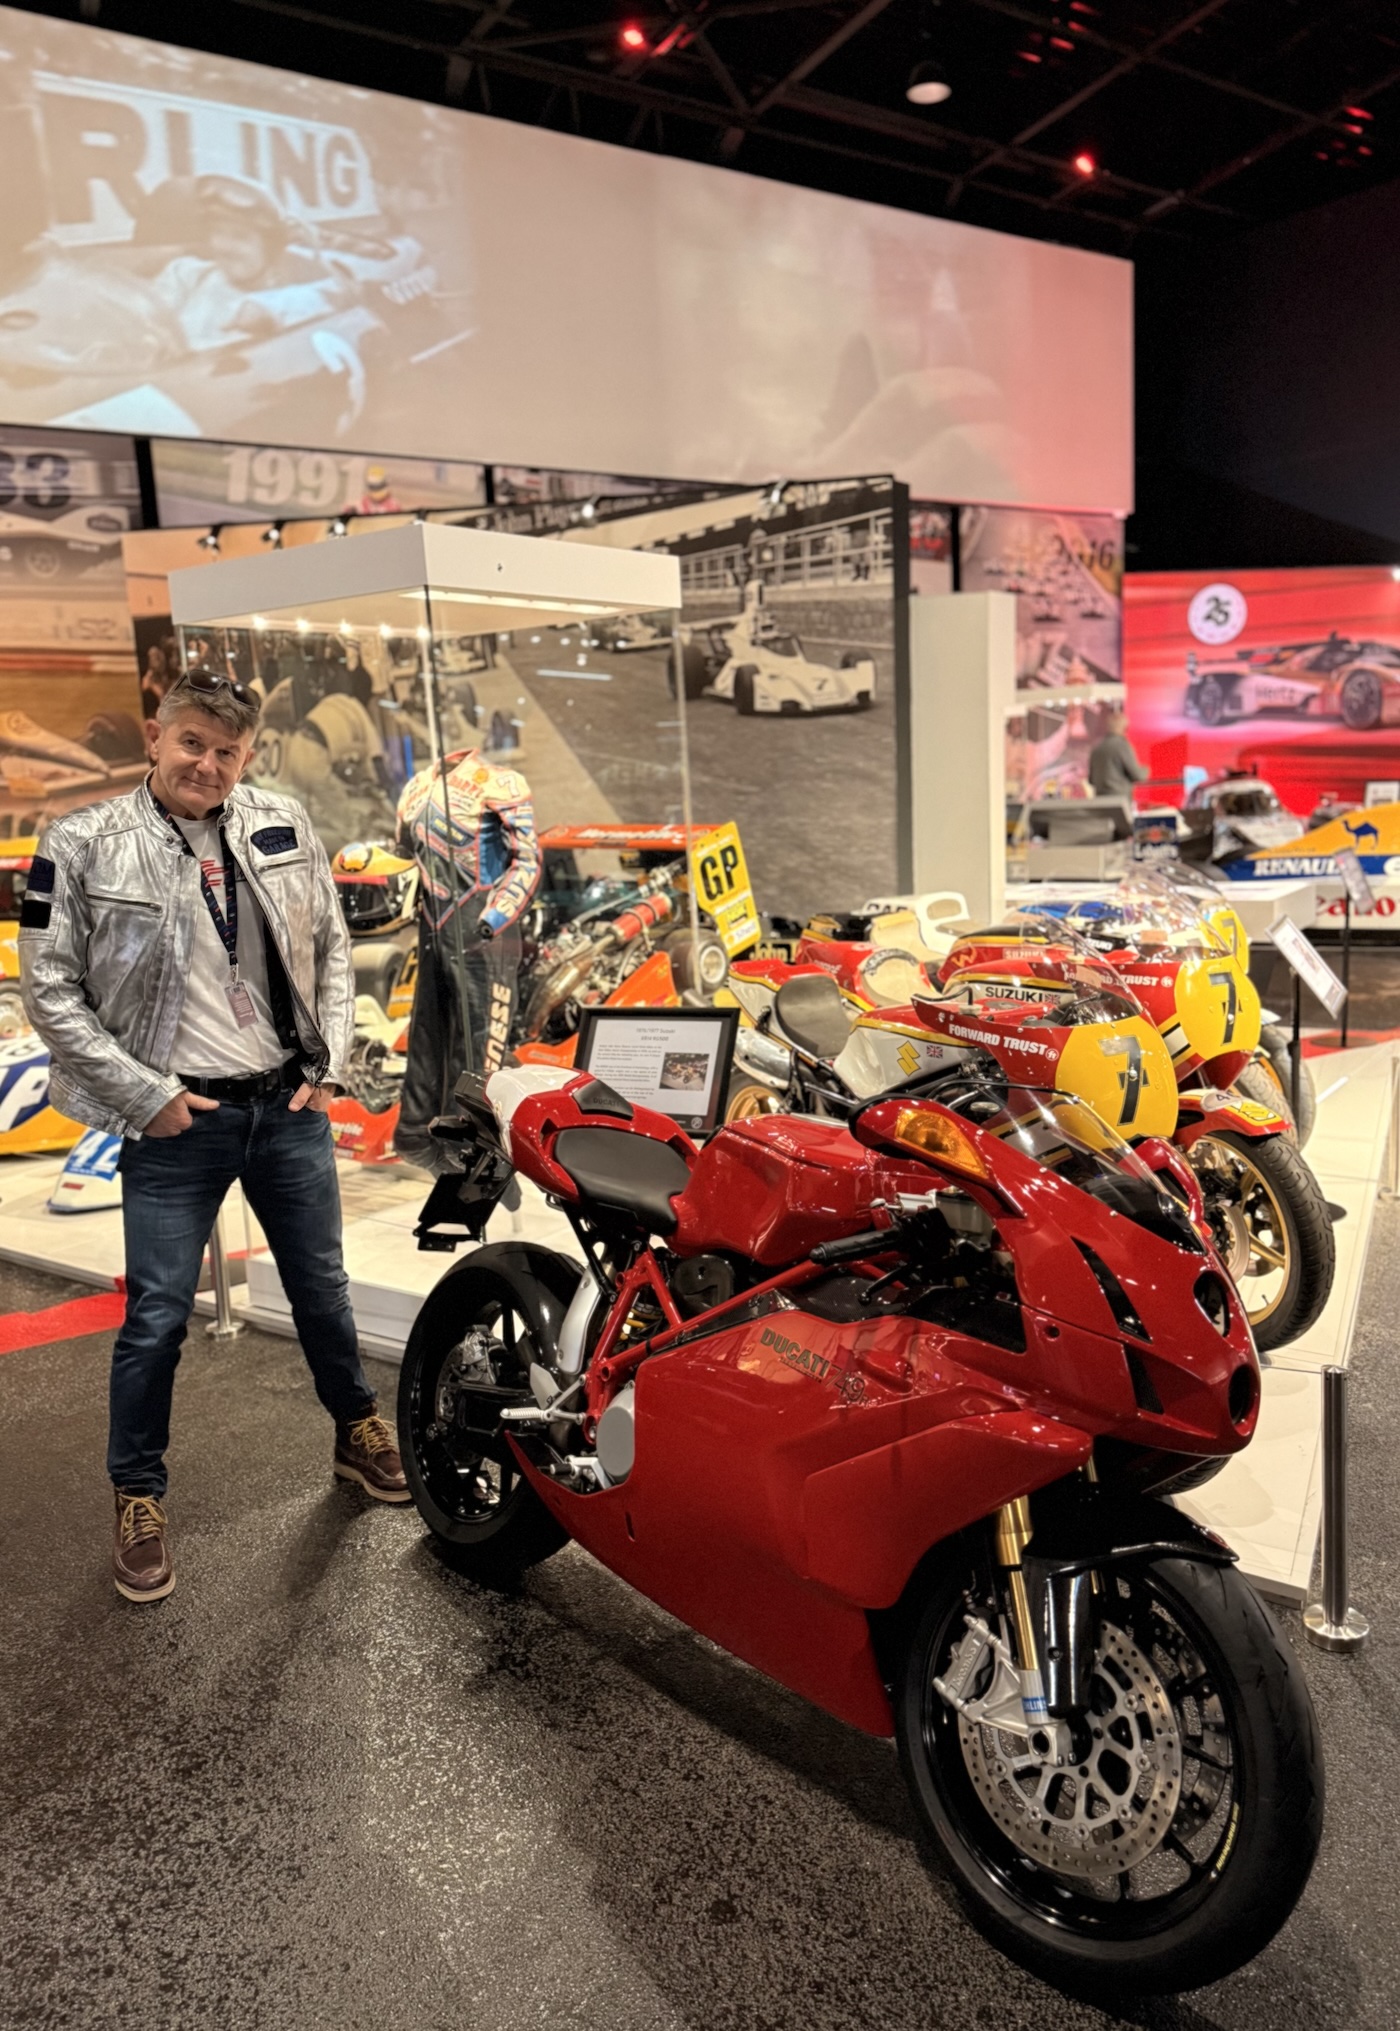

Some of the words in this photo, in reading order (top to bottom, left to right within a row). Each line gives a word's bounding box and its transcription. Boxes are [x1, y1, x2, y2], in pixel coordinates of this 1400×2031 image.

[222, 447, 367, 508] 1991
[496, 774, 520, 799] 7
[262, 839, 296, 854] GARAGE
[496, 816, 537, 917] SUZUKI
[700, 845, 739, 901] GP
[1252, 857, 1342, 877] RENAUL
[985, 986, 1043, 1003] SUZUKI
[1120, 975, 1160, 987] TRUST
[1208, 971, 1243, 1047] 7
[948, 1023, 1001, 1046] FORWARD
[1003, 1036, 1048, 1056] TRUST
[1098, 1034, 1150, 1127] 7
[760, 1327, 831, 1378] DUCATI
[1024, 1697, 1048, 1712] HLINS
